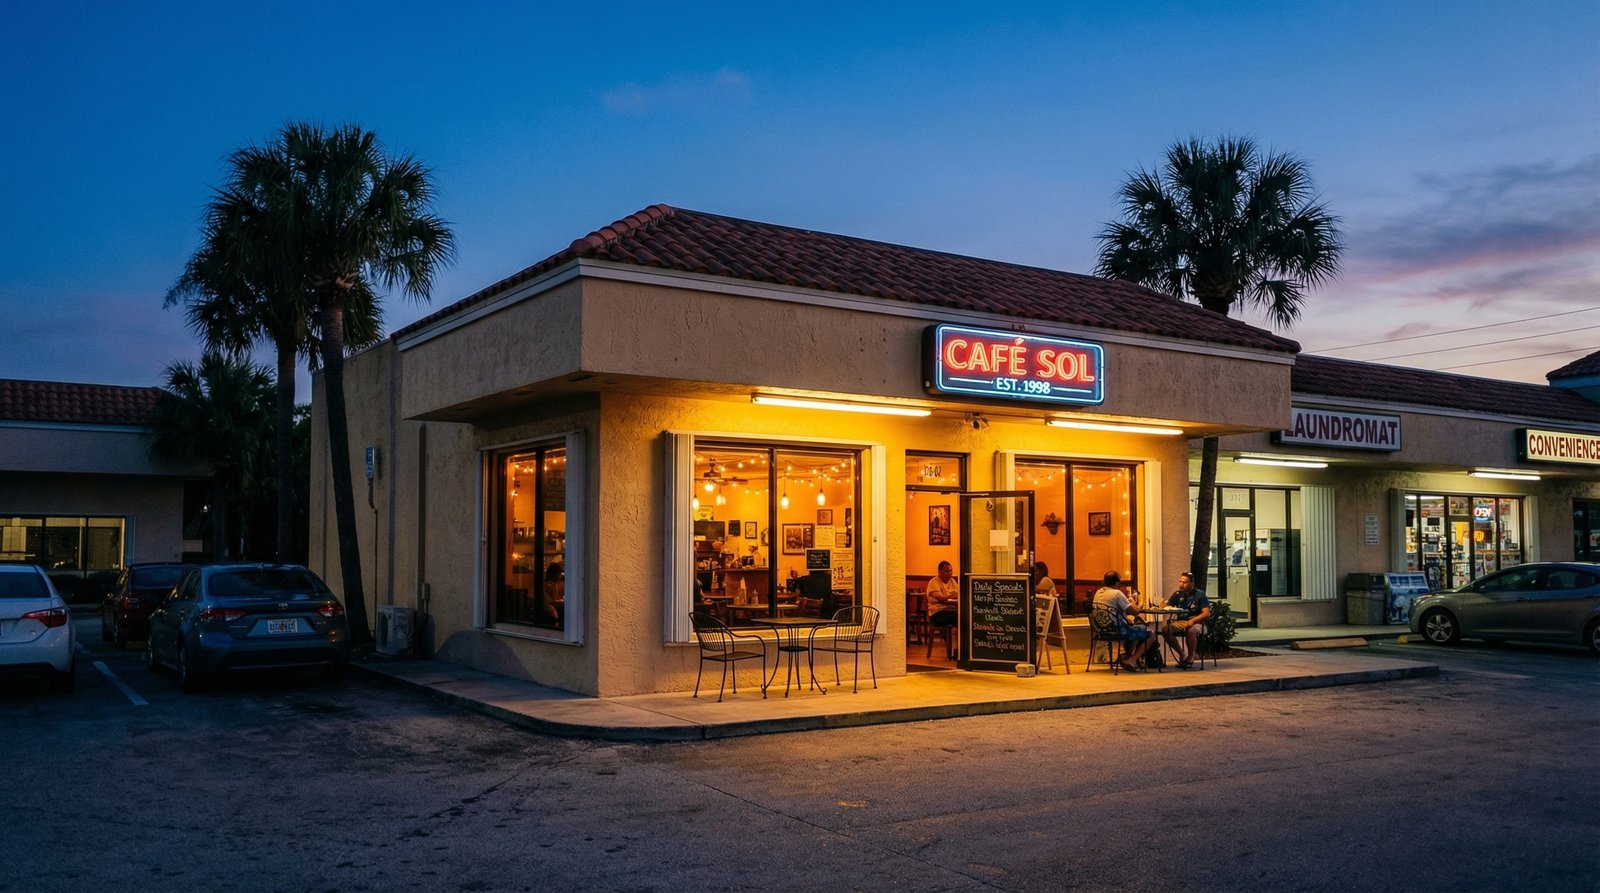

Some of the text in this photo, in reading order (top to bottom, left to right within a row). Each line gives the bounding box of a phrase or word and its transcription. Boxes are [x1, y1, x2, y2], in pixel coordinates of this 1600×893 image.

[945, 337, 1095, 382] CAFÉ SOL
[996, 377, 1051, 394] EST. 1998
[1529, 433, 1600, 460] CONVENIENCE
